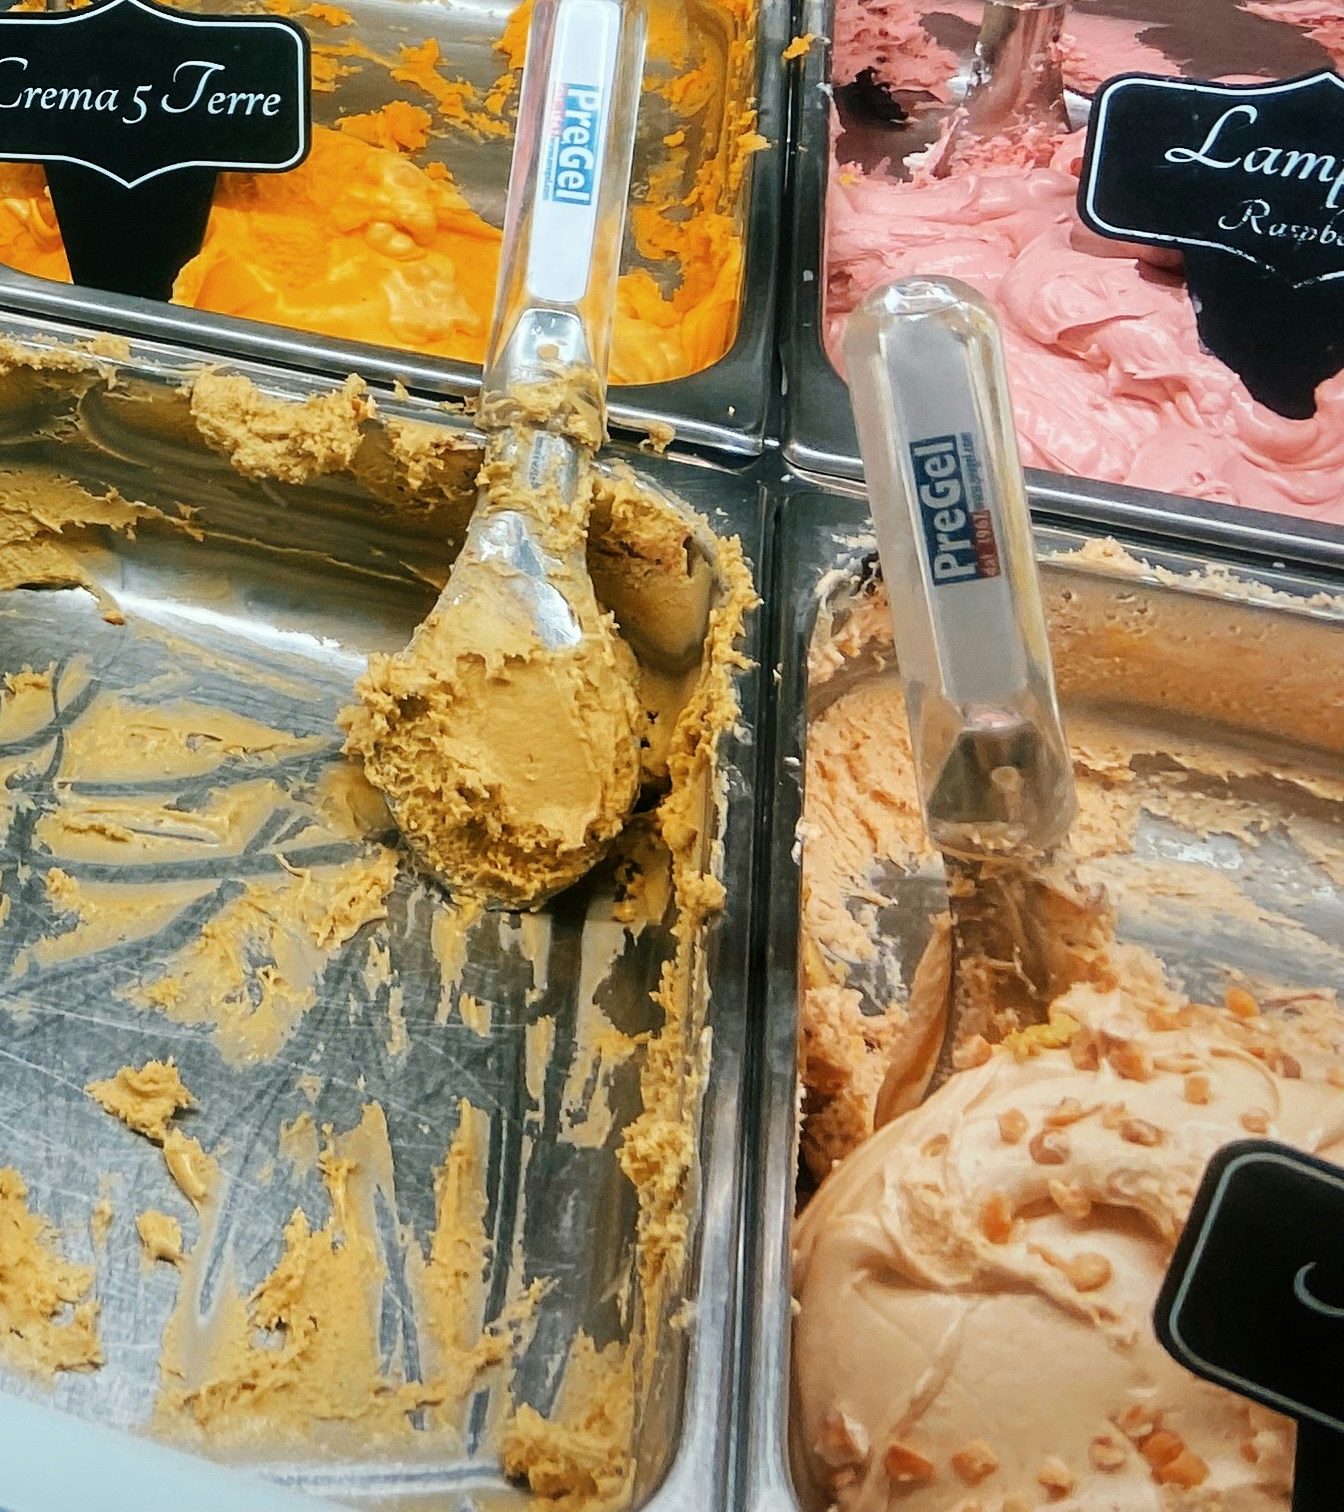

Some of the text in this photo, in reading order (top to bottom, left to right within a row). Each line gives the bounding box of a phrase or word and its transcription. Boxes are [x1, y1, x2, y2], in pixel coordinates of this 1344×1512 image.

[122, 84, 153, 124] 5
[161, 60, 281, 116] Terre
[555, 89, 600, 201] PreGel
[914, 441, 976, 579] PreGel
